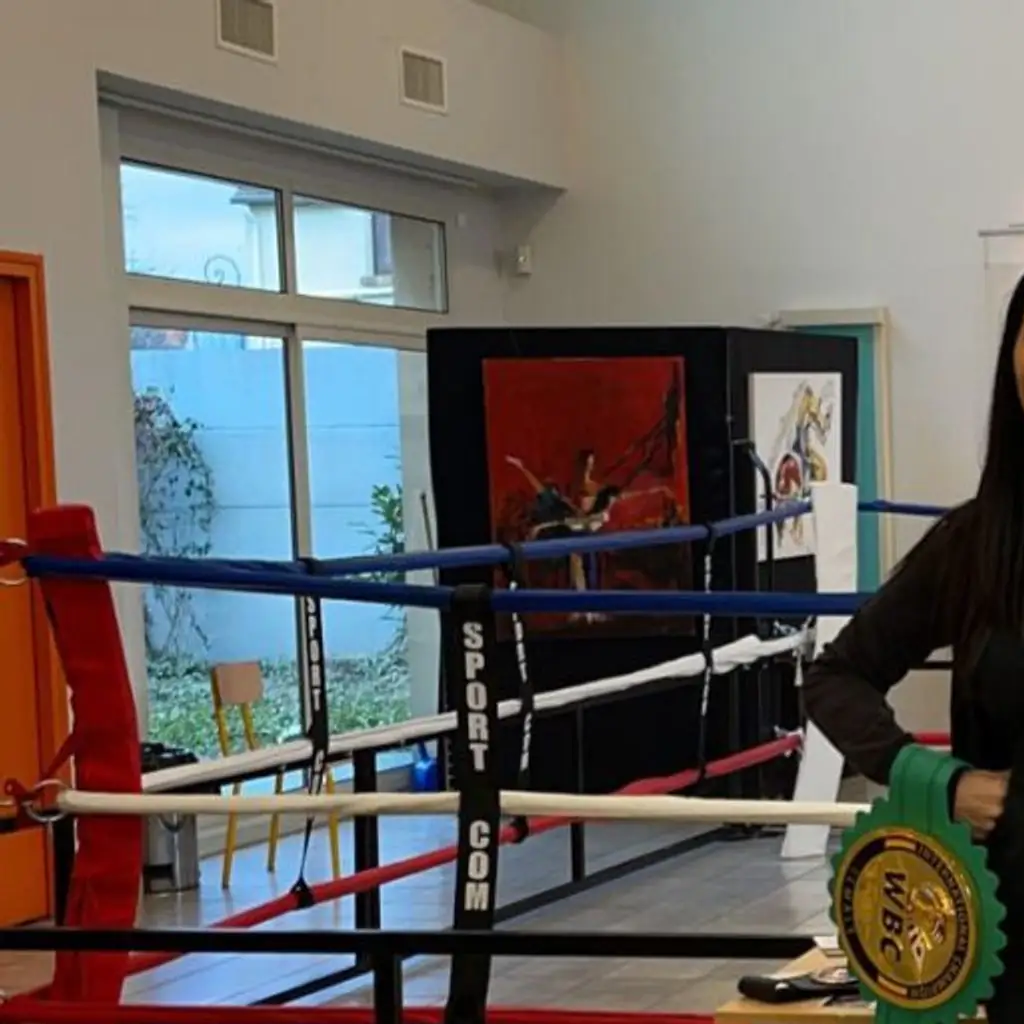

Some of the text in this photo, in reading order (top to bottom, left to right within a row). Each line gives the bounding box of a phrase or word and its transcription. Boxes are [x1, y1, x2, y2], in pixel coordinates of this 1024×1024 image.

[463, 621, 490, 911] SPORT COM
[880, 871, 907, 962] WBC
